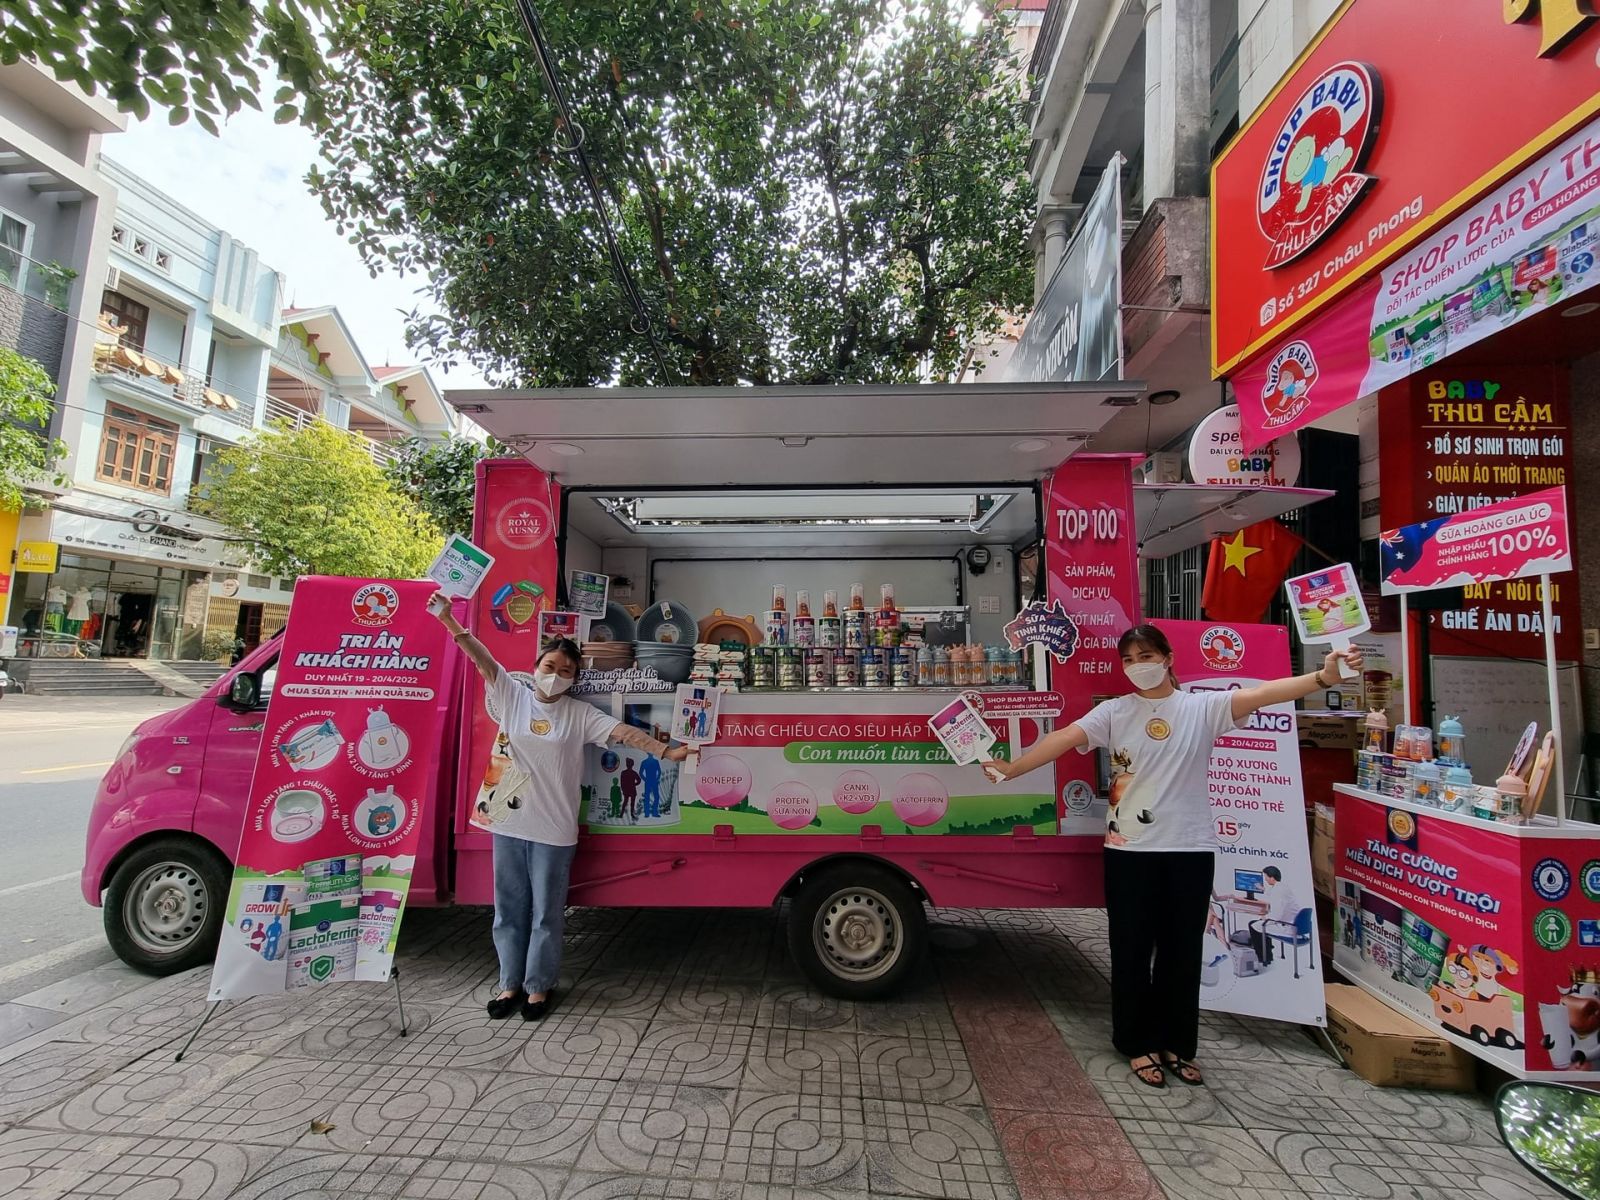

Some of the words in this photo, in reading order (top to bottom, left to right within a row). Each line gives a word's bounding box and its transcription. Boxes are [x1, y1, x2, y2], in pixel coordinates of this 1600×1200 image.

[1264, 109, 1304, 198] SHOP
[1311, 76, 1361, 113] BABY
[1530, 202, 1552, 224] SỮA
[1555, 175, 1598, 208] HOÀNG
[1389, 233, 1459, 296] SHOP
[1465, 167, 1550, 247] BABY
[1278, 286, 1295, 313] Số
[1298, 273, 1321, 297] 327
[1323, 241, 1363, 278] Châu
[1368, 196, 1423, 244] Phong
[1386, 295, 1402, 315] ĐỐI
[1405, 284, 1422, 303] TÁC
[1424, 264, 1454, 290] CHIẾN
[1457, 243, 1488, 270] LƯỢC
[1491, 227, 1515, 248] CỦA
[1266, 355, 1283, 392] SHOP
[1288, 347, 1312, 369] BABY
[1428, 380, 1500, 400] BABY
[1428, 403, 1483, 422] THU
[1494, 396, 1553, 423] CẦM
[1455, 435, 1471, 454] SƠ
[1475, 437, 1504, 455] SINH
[1507, 438, 1539, 459] TRỌN
[1542, 435, 1563, 456] GÓI
[1473, 462, 1489, 483] ÁO
[1493, 462, 1520, 484] THỜI
[1524, 466, 1565, 485] TRANG
[1436, 492, 1464, 513] GIÀY
[508, 518, 541, 526] ROYAL
[1057, 509, 1088, 540] TOP
[1092, 509, 1117, 539] 100
[1441, 528, 1461, 541] SỮA
[1464, 519, 1503, 536] HOÀNG
[1506, 516, 1527, 527] GIA
[508, 527, 541, 535] AUSNZ
[150, 536, 176, 548] 2HAND
[1438, 546, 1461, 557] NHẬP
[1462, 539, 1486, 551] KHẨU
[1487, 525, 1557, 557] 100%
[445, 550, 482, 575] Lactoferrin
[1437, 556, 1466, 567] CHÍNH
[1467, 550, 1489, 561] HÃNG
[1065, 562, 1084, 577] SẢN
[1086, 562, 1116, 579] PHẨM,
[357, 587, 375, 603] SHOP
[379, 587, 395, 603] BABY
[1072, 587, 1095, 600] DỊCH
[1098, 587, 1111, 600] VỤ
[1507, 579, 1530, 601] NÔI
[1025, 614, 1046, 625] SỮA
[1070, 612, 1086, 626] TỐT
[1089, 611, 1115, 626] NHẤT
[1442, 607, 1479, 630] GHẾ
[1485, 609, 1512, 631] ĂN
[340, 634, 372, 648] TRI
[373, 630, 404, 649] ÂN
[1014, 625, 1037, 639] TINH
[1039, 624, 1067, 638] KHIẾT
[1204, 630, 1219, 646] SHOP
[1223, 630, 1240, 647] BABY
[1083, 637, 1100, 648] GIA
[295, 649, 370, 669] KHÁCH
[371, 651, 429, 670] HÀNG
[1078, 658, 1095, 673] TRẺ
[1098, 661, 1112, 673] EM
[327, 673, 354, 682] NHẤT
[372, 675, 418, 683] 20/4/2022
[629, 681, 647, 691] 160
[287, 687, 309, 695] MUA
[312, 686, 330, 695] SỮA
[332, 689, 348, 698] XỊN
[355, 687, 382, 698] NHẬN
[383, 687, 403, 697] QUÀ
[725, 723, 765, 737] TĂNG
[769, 721, 814, 737] CHIỀU
[818, 724, 850, 737] CAO
[854, 723, 888, 737] SIÊU
[891, 722, 921, 737] HẤP
[941, 713, 974, 739] Lactoferrin
[799, 745, 831, 760] Con
[837, 744, 887, 761] muốn
[891, 746, 920, 761] lùn
[1231, 740, 1275, 749] 20/4/2022
[347, 742, 355, 759] MUA
[352, 763, 368, 775] LON
[1217, 757, 1233, 768] ĐỘ
[1236, 759, 1277, 771] XƯƠNG
[701, 776, 743, 784] BONEPEP
[1207, 768, 1247, 782] RƯỞNG
[1249, 773, 1291, 786] THÀNH
[1209, 784, 1225, 795] DỰ
[1228, 785, 1261, 797] ĐOÁN
[260, 794, 275, 808] LON
[776, 797, 809, 805] PROTEIN
[1209, 797, 1231, 808] CAO
[1234, 800, 1259, 810] CHO
[1262, 800, 1285, 812] TRẺ
[1217, 821, 1238, 836] 15
[1239, 847, 1267, 857] chính
[1270, 849, 1289, 859] xác
[1367, 840, 1399, 860] TĂNG
[1401, 852, 1458, 880] CƯỜNG
[1346, 848, 1371, 866] MIỄN
[1374, 859, 1403, 880] DỊCH
[1407, 871, 1451, 896] VƯỢT
[1455, 887, 1501, 913] TRỘI
[245, 903, 277, 913] GROW
[1399, 889, 1412, 898] CHO
[1414, 895, 1428, 905] CON
[1430, 901, 1457, 916] TRONG
[1458, 911, 1473, 922] ĐẠI
[1475, 917, 1498, 931] DỊCH
[288, 926, 359, 950] Lactoferrin
[1362, 919, 1402, 944] Lactoferrin
